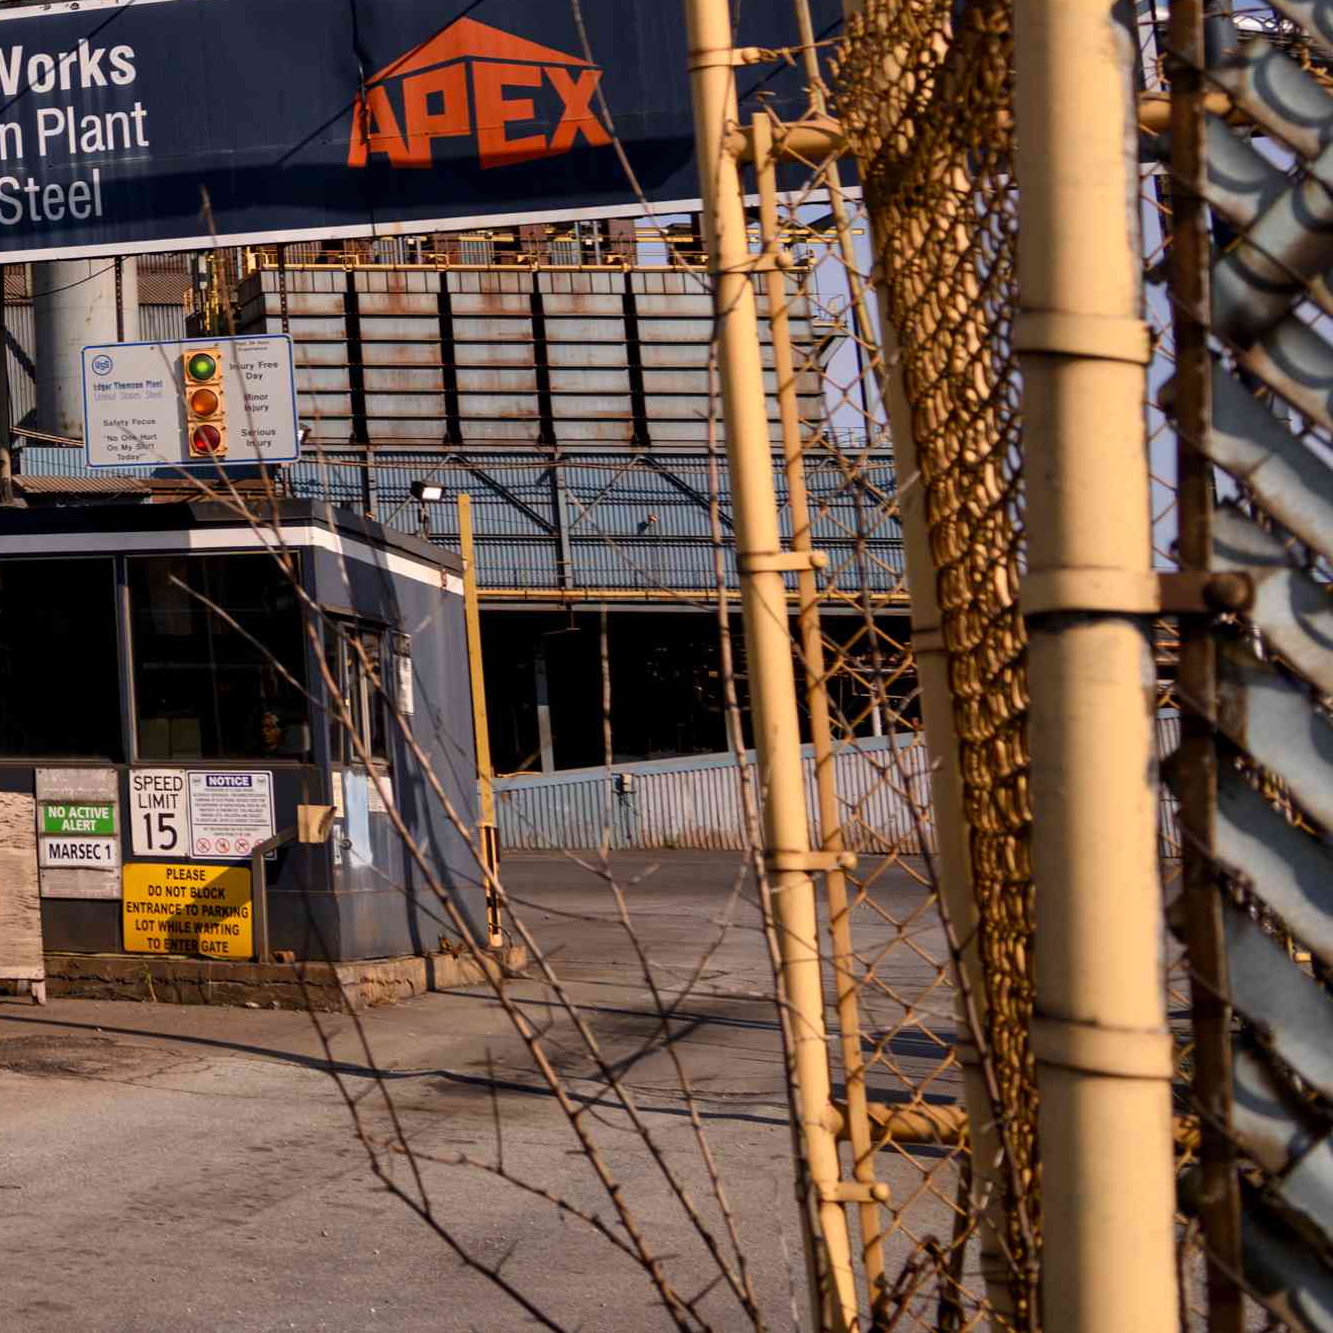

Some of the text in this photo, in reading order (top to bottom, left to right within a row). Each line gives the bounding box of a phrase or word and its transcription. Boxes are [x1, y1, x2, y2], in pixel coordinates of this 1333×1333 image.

[348, 57, 613, 170] APEX
[36, 102, 150, 157] Plant
[229, 361, 279, 371] Injury Free
[246, 372, 264, 381] Day
[244, 393, 269, 401] Minor
[103, 418, 157, 427] Safety Focus
[241, 428, 276, 437] Serious
[121, 444, 132, 452] My
[133, 776, 183, 791] SPEED
[208, 776, 250, 786] NOTICE
[138, 793, 179, 809] LIMIT
[48, 806, 109, 819] NO ACTIVE
[61, 819, 97, 832] ALERT
[143, 813, 178, 851] 15
[49, 843, 112, 860] MARSEC 1
[166, 868, 206, 881] PLEASE
[148, 885, 226, 900] DO NOT BLOCK
[126, 901, 249, 919] ENTRANCE TO PARKING
[135, 920, 240, 936] LOT WHILE WAITING
[147, 937, 230, 953] TO ENTER GATE
